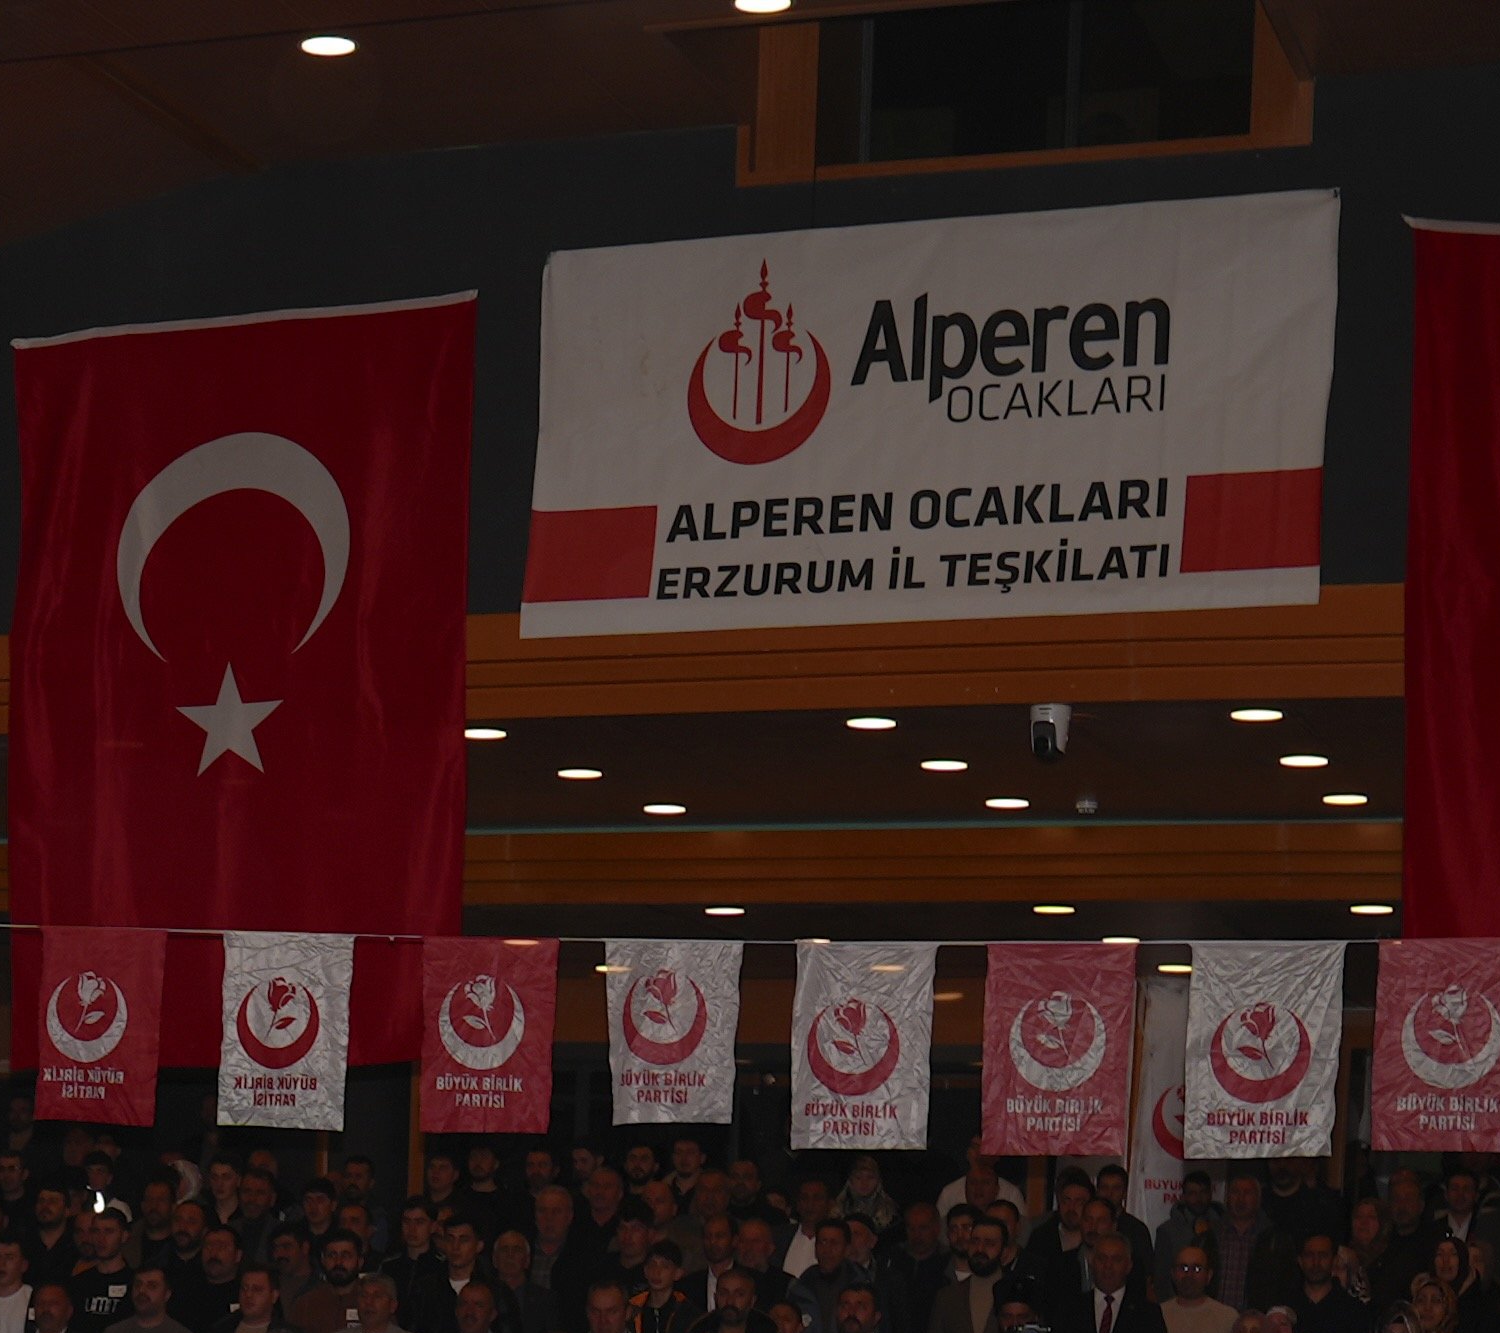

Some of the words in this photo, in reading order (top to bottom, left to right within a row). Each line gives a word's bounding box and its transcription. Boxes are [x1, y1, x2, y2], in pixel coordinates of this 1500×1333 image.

[851, 292, 1170, 403] Alperen
[946, 374, 1166, 423] OCAKLARI
[666, 492, 893, 543] ALPEREN
[909, 478, 1168, 530] OCAKLARI
[656, 558, 873, 601] ERZURUM
[889, 546, 926, 590] İL
[939, 538, 1169, 594] TEŞKİLATI
[436, 1074, 478, 1091] BÜYÜK
[664, 1070, 706, 1087] BİRLİK
[455, 1091, 505, 1109] PARTİSİ
[637, 1088, 688, 1104] PARTİSİ
[1397, 1095, 1445, 1112] BÜYÜK
[805, 1100, 846, 1117] BÜYÜK
[852, 1102, 898, 1119] BİRLİK
[1206, 1109, 1252, 1126] BÜYÜK
[1259, 1110, 1309, 1126] BİRLİK
[823, 1119, 875, 1137] PARTİSİ
[1027, 1114, 1081, 1132] PARTİSİ
[1419, 1112, 1475, 1131] PARTİSİ
[1229, 1128, 1286, 1145] PARTİSİ
